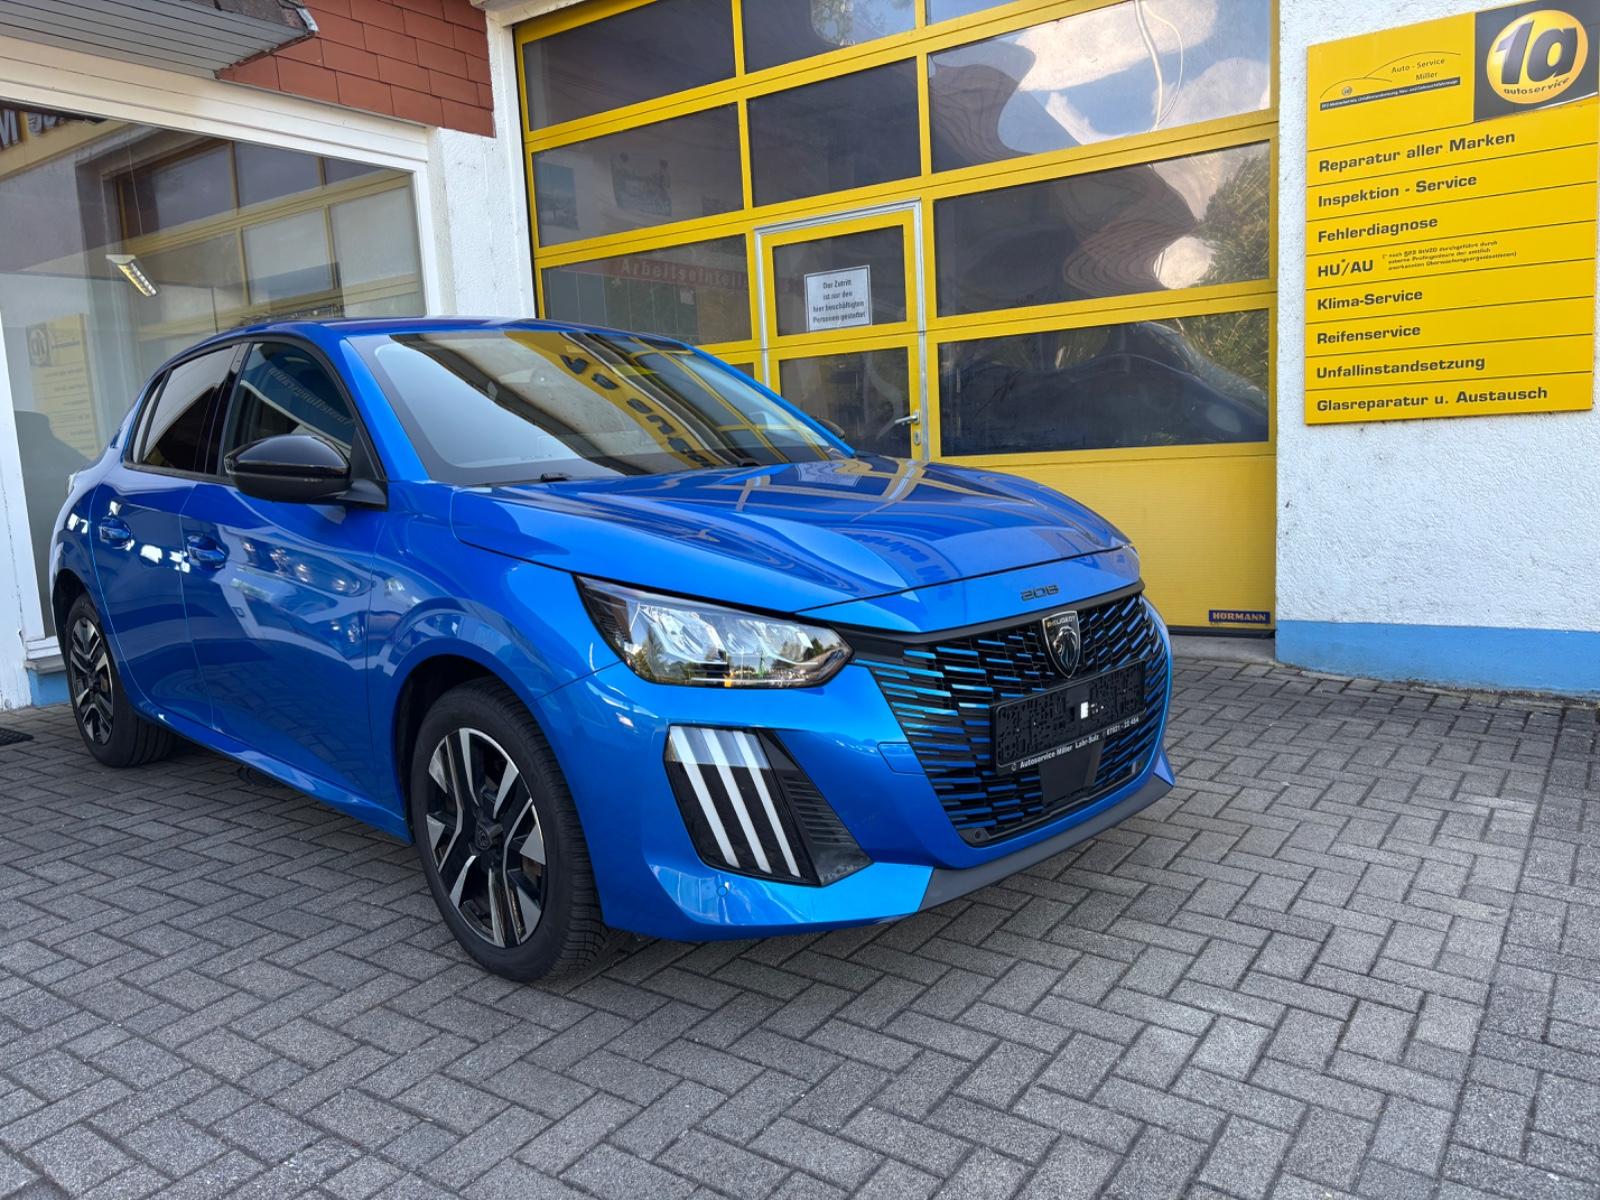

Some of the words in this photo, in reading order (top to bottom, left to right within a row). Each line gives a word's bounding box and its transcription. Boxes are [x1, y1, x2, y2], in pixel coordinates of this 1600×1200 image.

[1495, 19, 1578, 85] 1a
[1391, 64, 1410, 74] Auto
[1416, 58, 1445, 69] Service
[1415, 72, 1438, 81] Miller
[1503, 77, 1570, 95] autoservice
[1318, 150, 1401, 173] Reparatur
[1406, 143, 1443, 160] aller
[1449, 132, 1516, 152] Marken
[1318, 186, 1400, 208] Inspektion
[1415, 174, 1478, 194] Service
[1317, 217, 1438, 243] Fehlerdiagnose
[834, 279, 852, 288] Zutritt
[813, 304, 825, 313] hier
[1317, 289, 1423, 311] Klima-Service
[1317, 325, 1421, 345] Reifenservice
[1316, 356, 1486, 379] Unfallinstandsetzung
[1317, 394, 1429, 412] Glasreparatur
[1434, 394, 1449, 405] u.
[1456, 386, 1548, 404] Austausch
[1046, 615, 1076, 628] PEUGEOT
[1020, 751, 1056, 769] Autoservice
[1056, 744, 1073, 756] Miller
